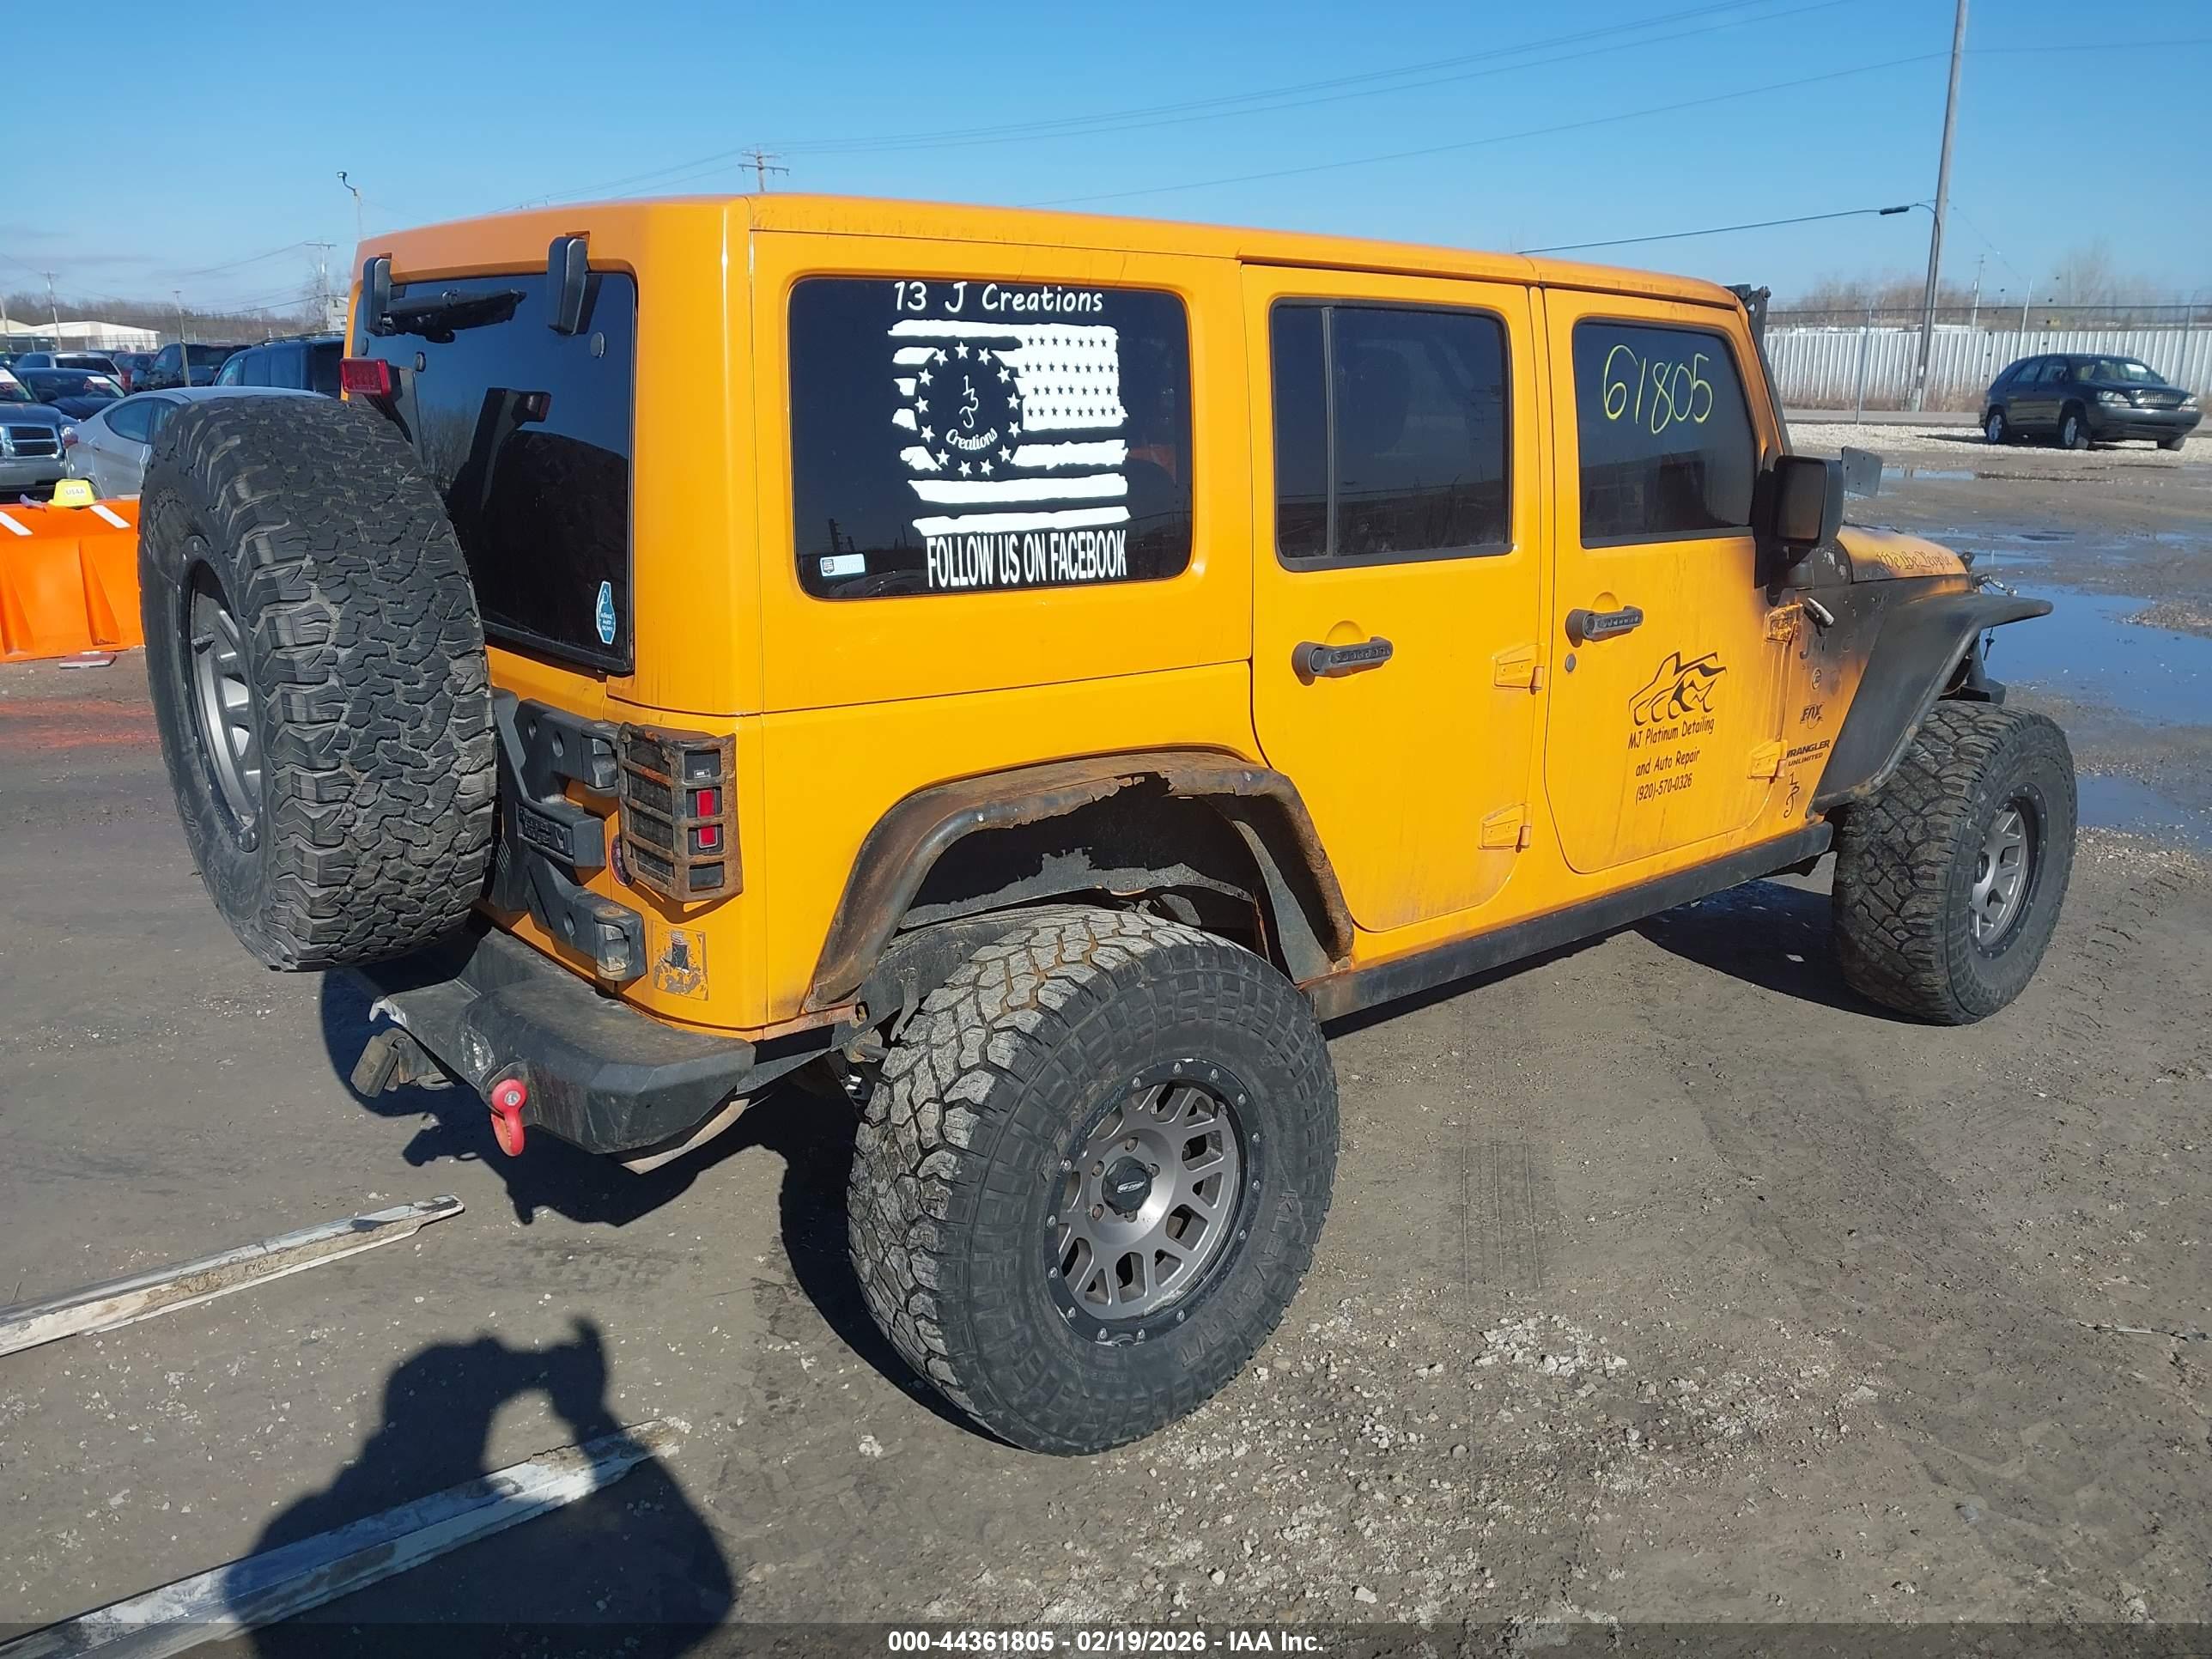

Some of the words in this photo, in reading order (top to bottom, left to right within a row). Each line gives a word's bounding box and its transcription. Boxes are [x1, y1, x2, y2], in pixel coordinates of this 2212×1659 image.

[894, 281, 927, 310] 13
[945, 281, 969, 313] J
[981, 283, 1103, 312] Creations
[1603, 344, 1713, 434] 61805
[945, 427, 998, 450] Creations
[926, 534, 994, 588] FOLLOW
[998, 533, 1020, 585] US
[1024, 532, 1047, 583] ON
[1050, 529, 1127, 581] FACEBOOK
[1628, 730, 1643, 750] MJ
[1645, 726, 1679, 746] Platinum
[1681, 714, 1715, 737] Detailing
[1635, 757, 1652, 776] and
[1654, 756, 1673, 772] Auto
[1675, 746, 1700, 769] Repair
[1788, 751, 1823, 767] UNLIMITED
[1635, 773, 1693, 805] (920)-570-0326
